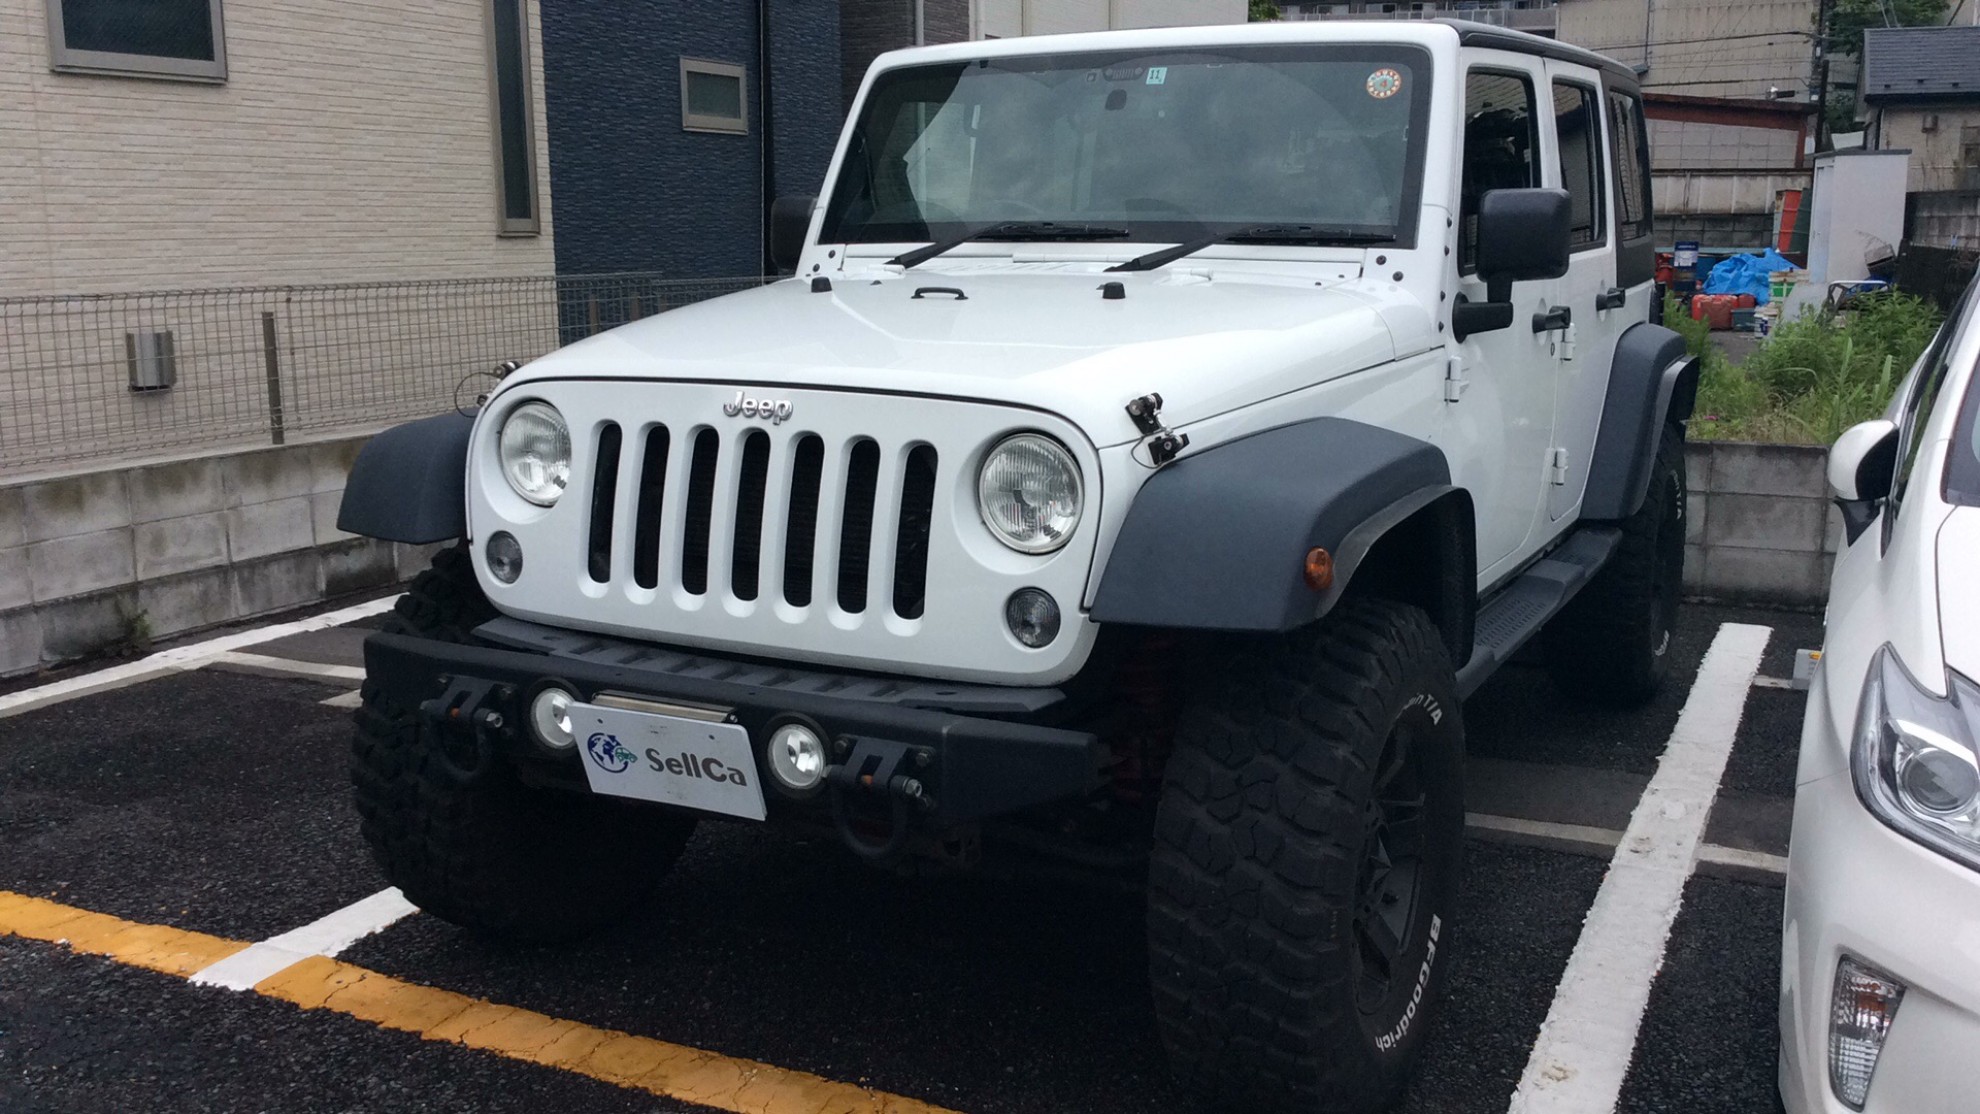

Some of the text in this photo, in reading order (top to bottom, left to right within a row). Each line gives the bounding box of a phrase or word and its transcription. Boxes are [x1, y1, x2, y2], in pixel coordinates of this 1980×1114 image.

[723, 391, 793, 426] Jeep
[645, 748, 747, 787] SellCa
[1375, 913, 1442, 1053] BFGoodrich
